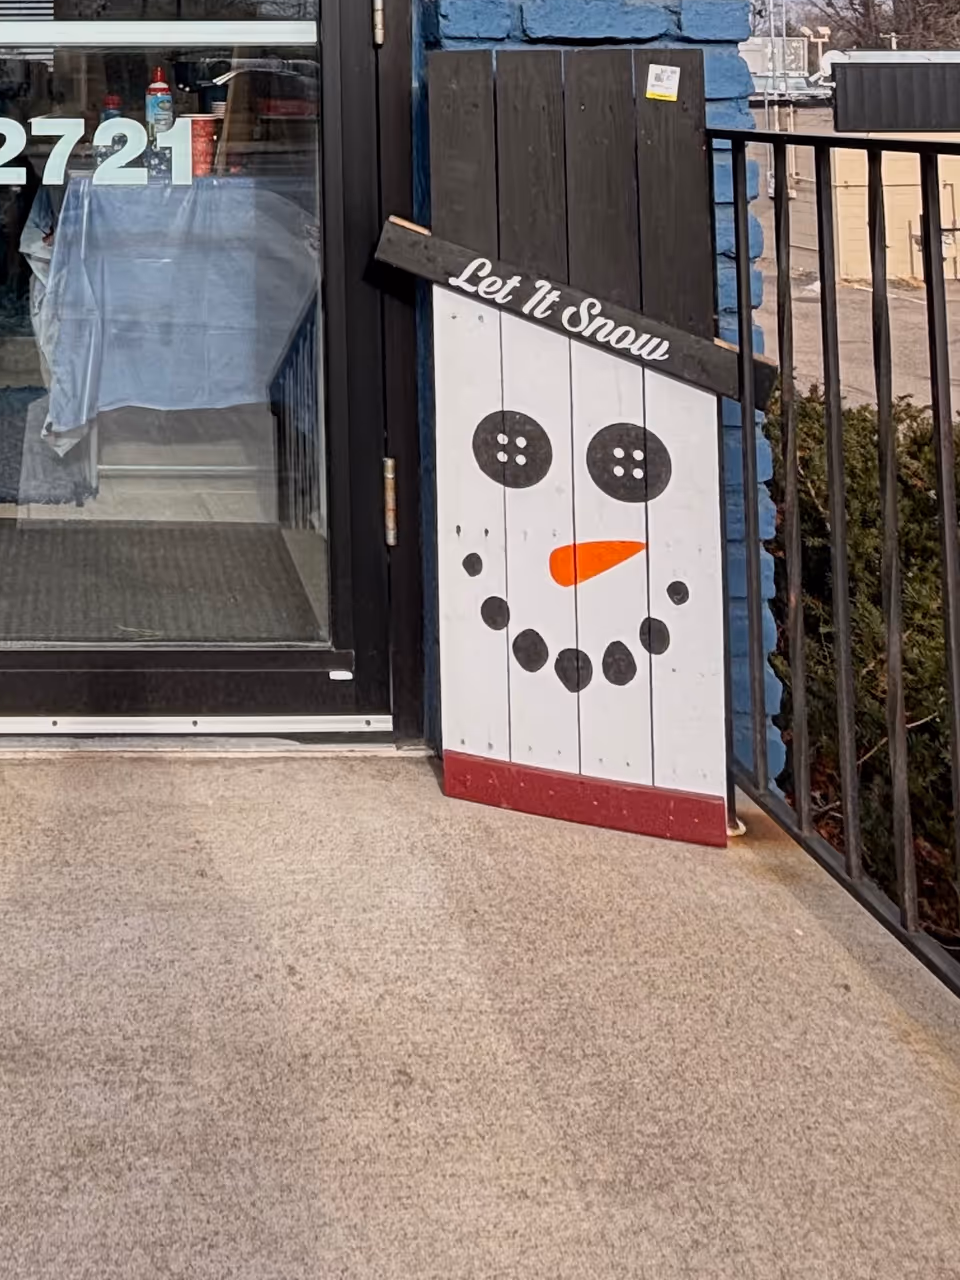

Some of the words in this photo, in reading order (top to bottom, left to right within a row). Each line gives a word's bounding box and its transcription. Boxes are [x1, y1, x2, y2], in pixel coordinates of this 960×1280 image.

[448, 257, 522, 304] Let
[522, 279, 563, 319] It
[561, 297, 670, 361] Snow
